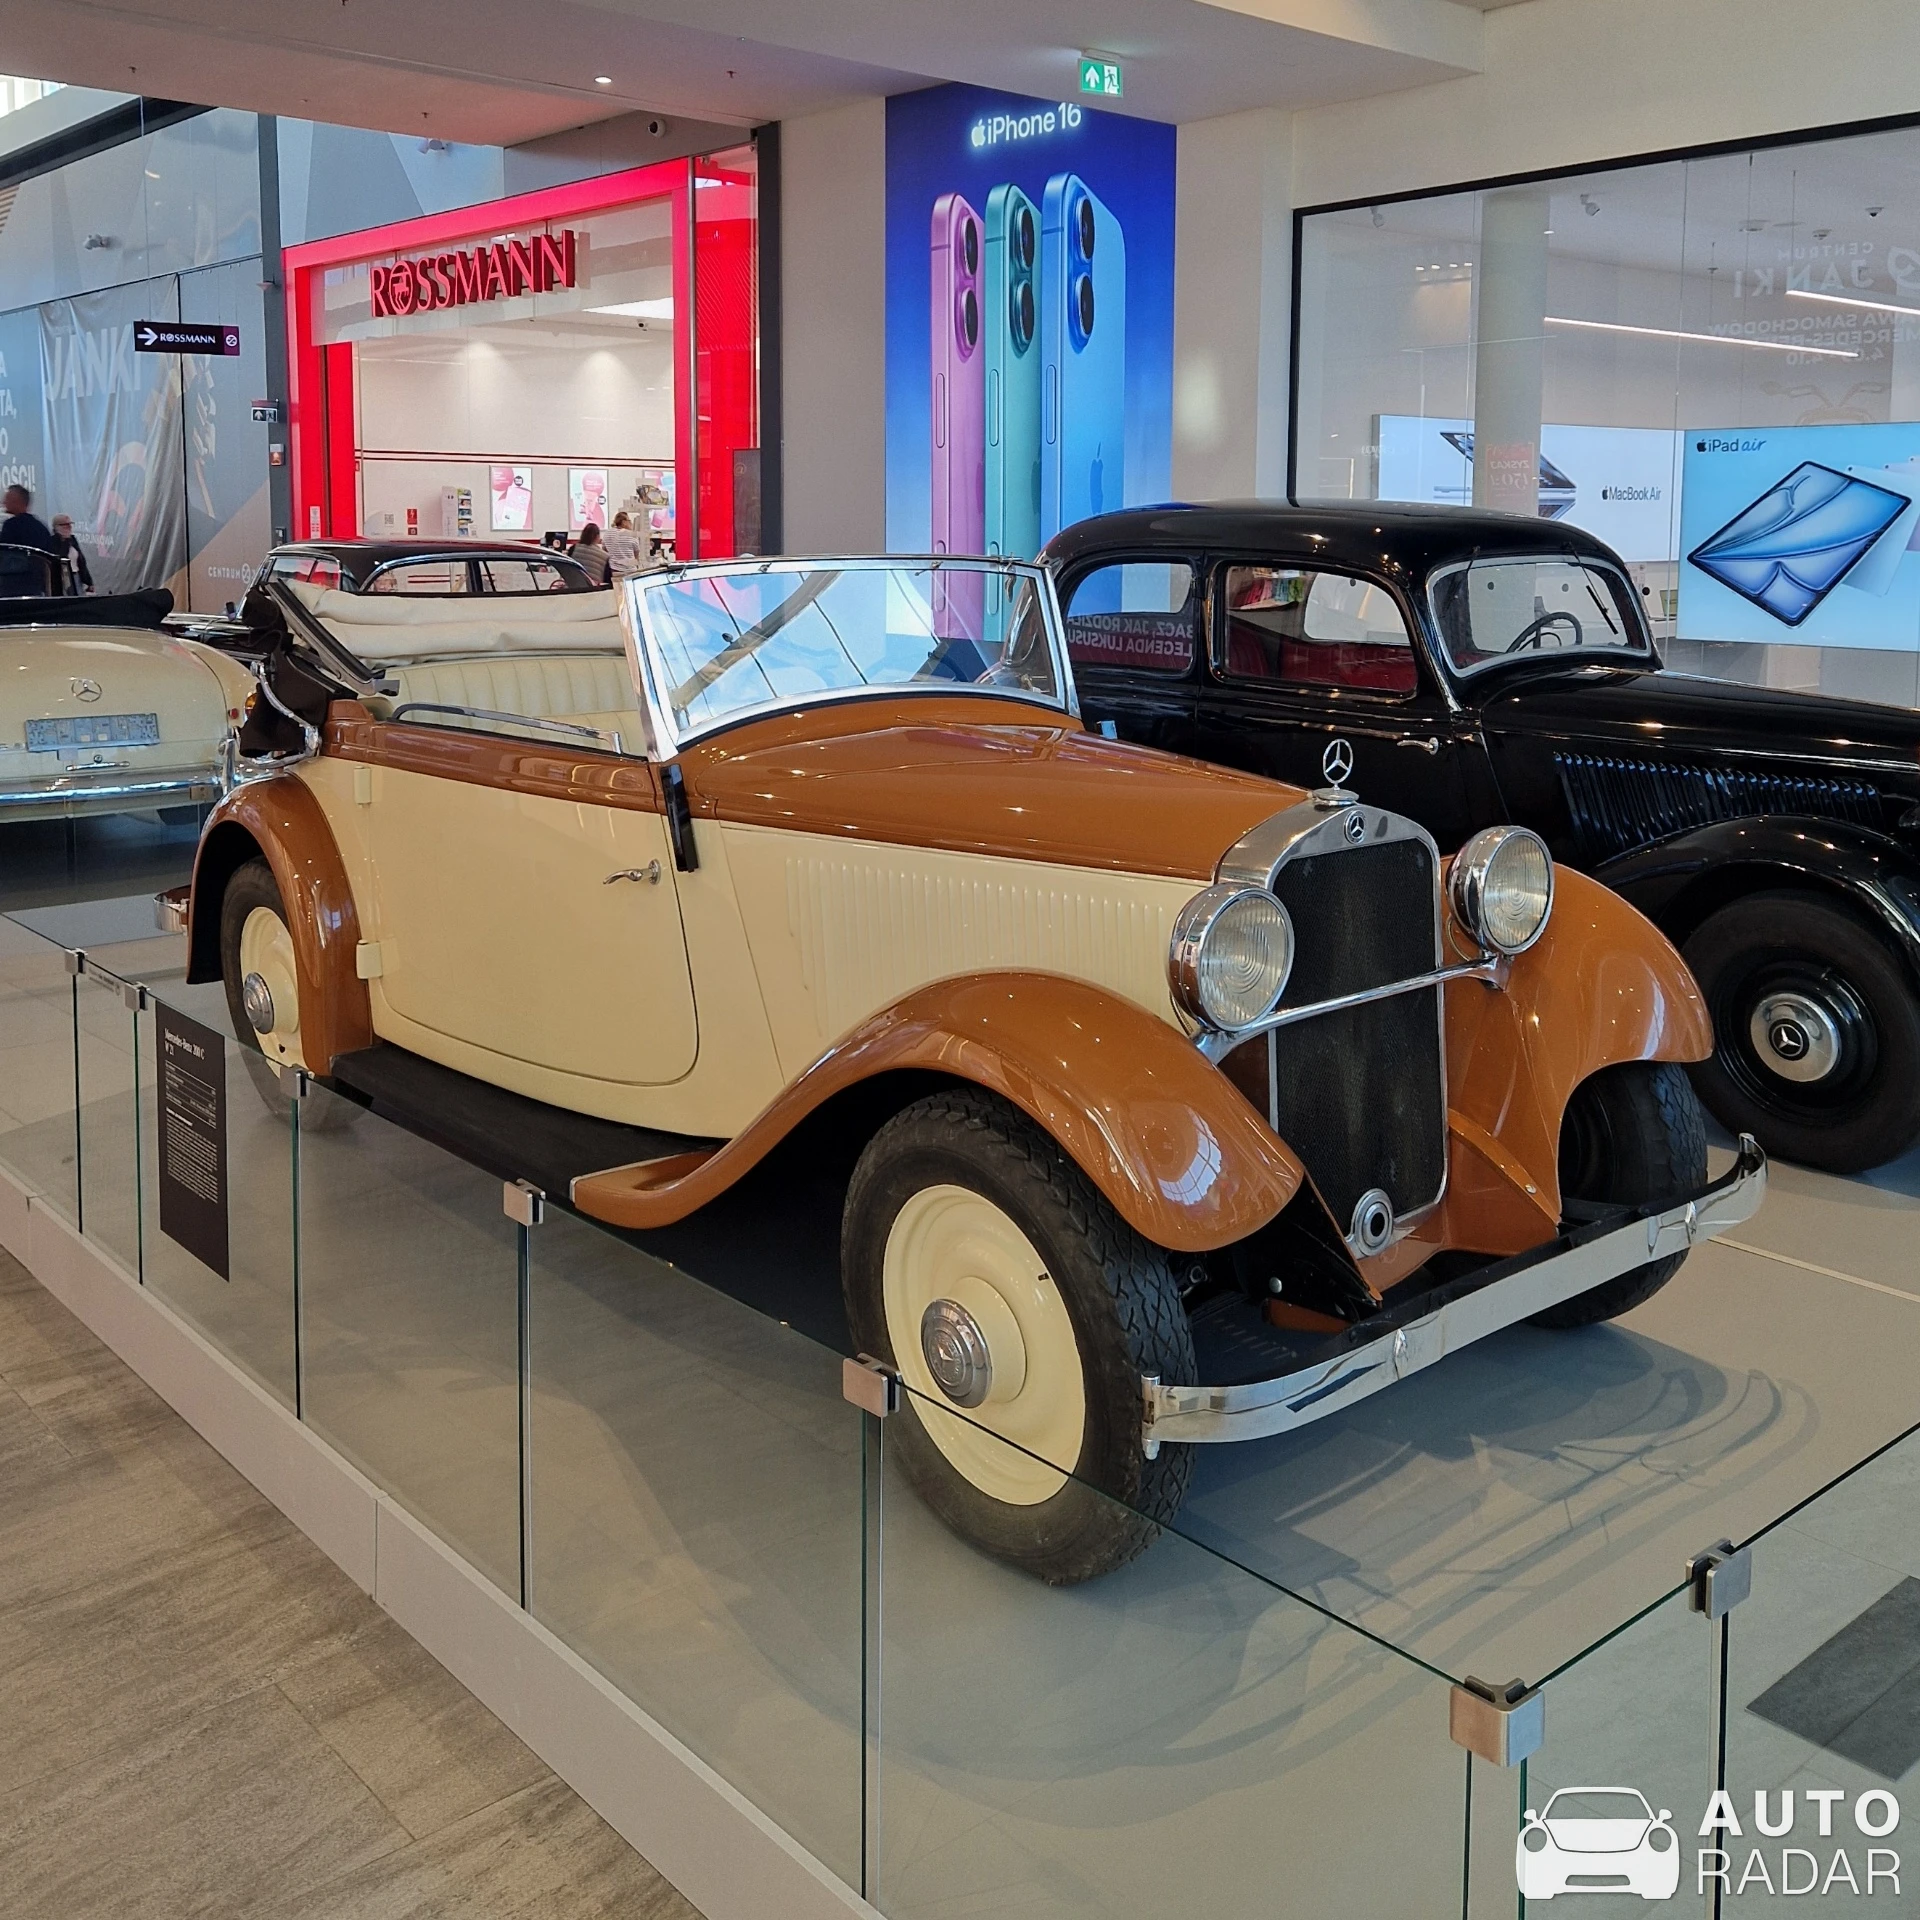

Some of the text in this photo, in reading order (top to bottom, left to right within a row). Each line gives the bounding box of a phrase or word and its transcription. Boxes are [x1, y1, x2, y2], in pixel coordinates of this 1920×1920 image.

[987, 102, 1082, 145] iPhone 16
[370, 229, 575, 317] ROSSMANN
[160, 333, 216, 344] ROSSMANN
[1708, 439, 1767, 452] iPad air
[0, 457, 36, 493] OŚCI!
[1609, 486, 1662, 500] MacBook Air
[207, 566, 241, 579] CENTRUM
